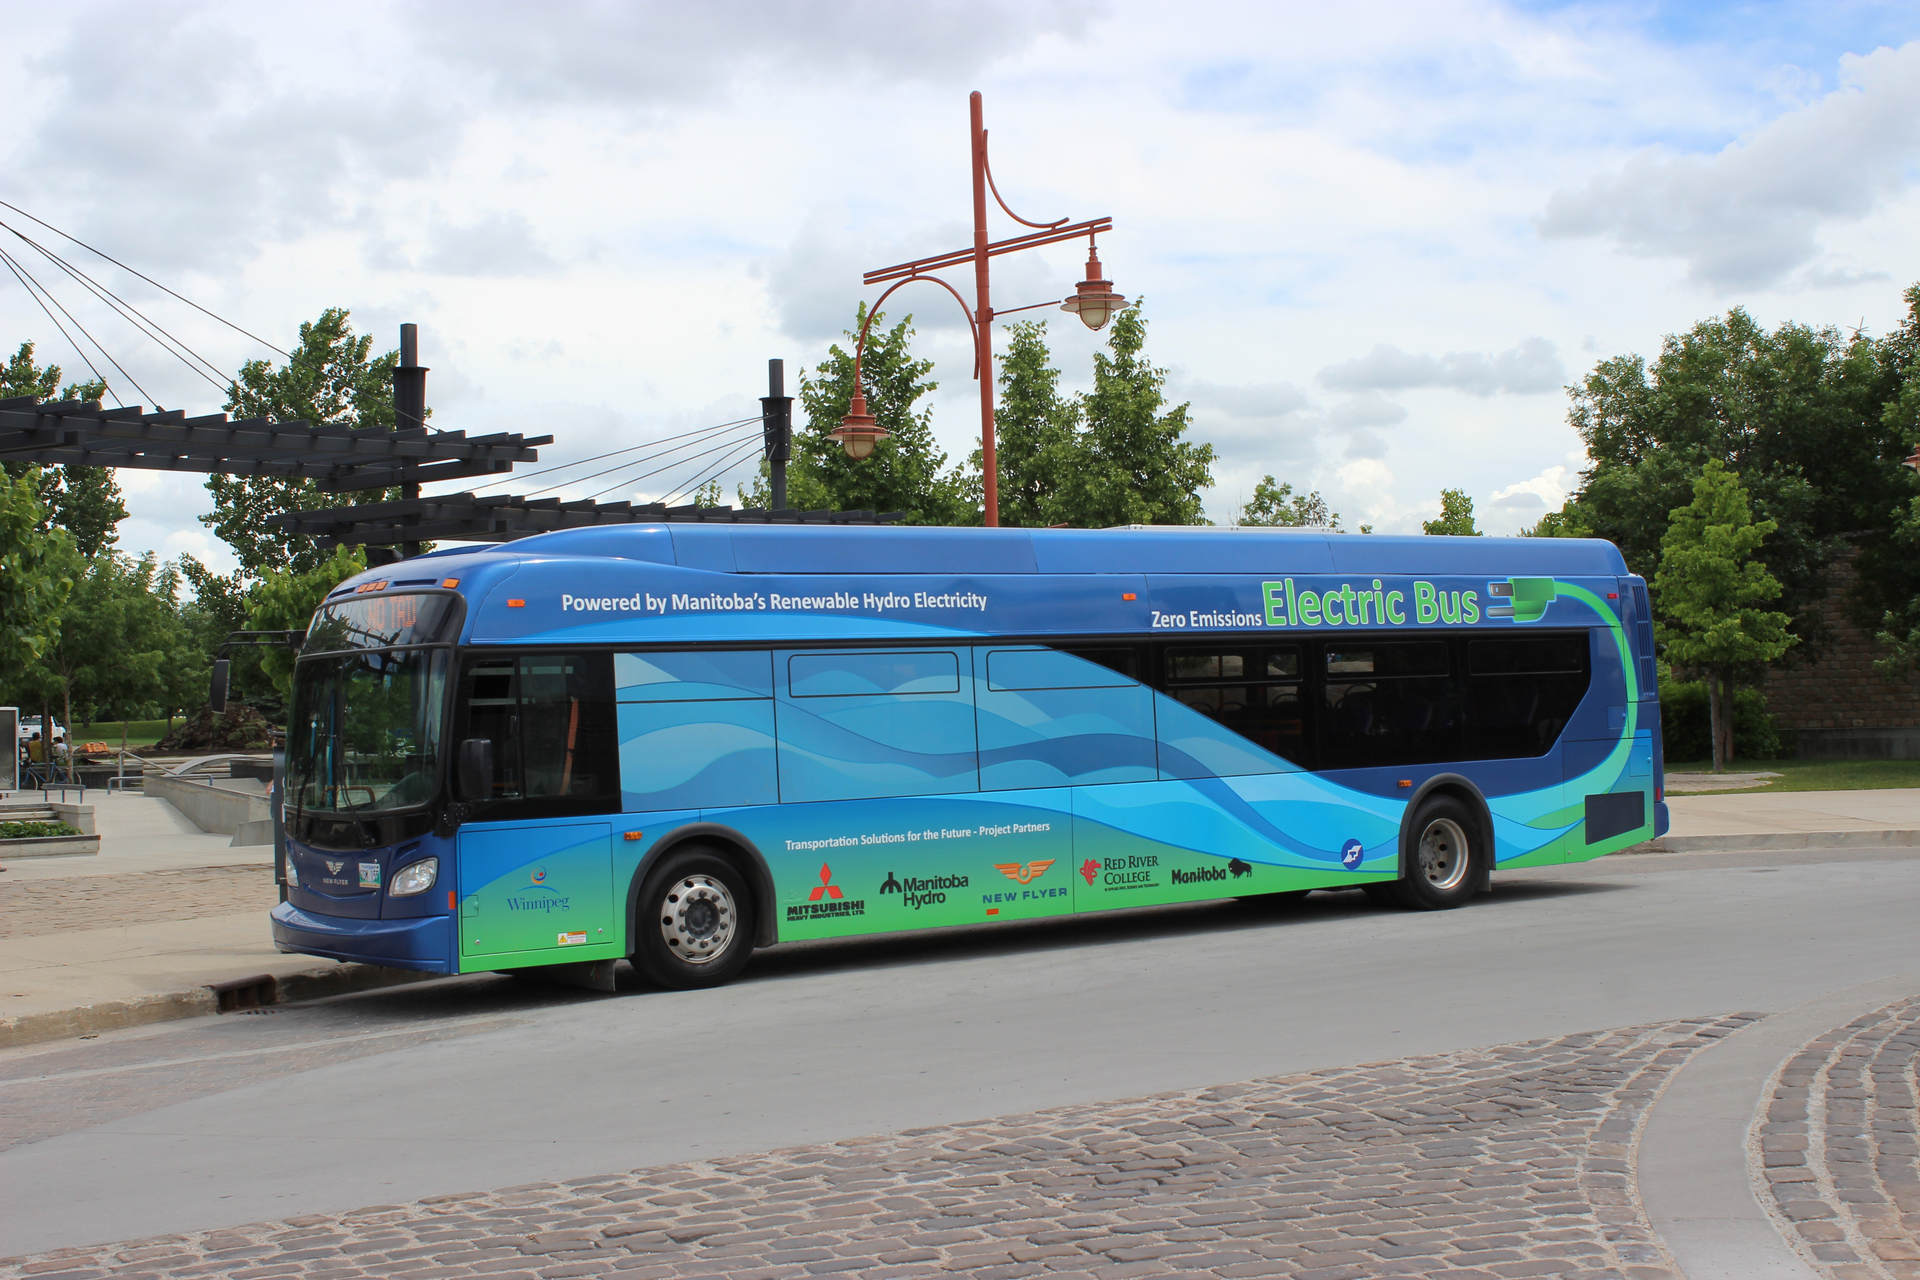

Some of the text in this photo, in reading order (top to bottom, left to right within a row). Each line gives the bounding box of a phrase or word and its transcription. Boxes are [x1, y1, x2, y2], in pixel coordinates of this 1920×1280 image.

[562, 592, 988, 614] Powered by Manitoba's Renewable Hydro Electricity
[1152, 578, 1480, 628] Zero Emissions Electric Bus
[368, 597, 386, 631] NO
[785, 836, 858, 851] Transportation
[861, 832, 906, 846] Solutions
[907, 831, 921, 842] for
[923, 830, 939, 840] the
[941, 828, 972, 839] Future
[979, 824, 1012, 837] Project
[1013, 823, 1050, 834] Partners
[1104, 856, 1160, 870] RED RIVER
[903, 874, 968, 892] Manitoba
[1104, 871, 1151, 885] COLLEGE
[1172, 866, 1226, 884] Manitoba
[507, 896, 570, 913] Winnipeg
[903, 890, 946, 910] Hydro
[982, 887, 1068, 904] NEW FLYER
[787, 900, 864, 916] MITSUBISHI
